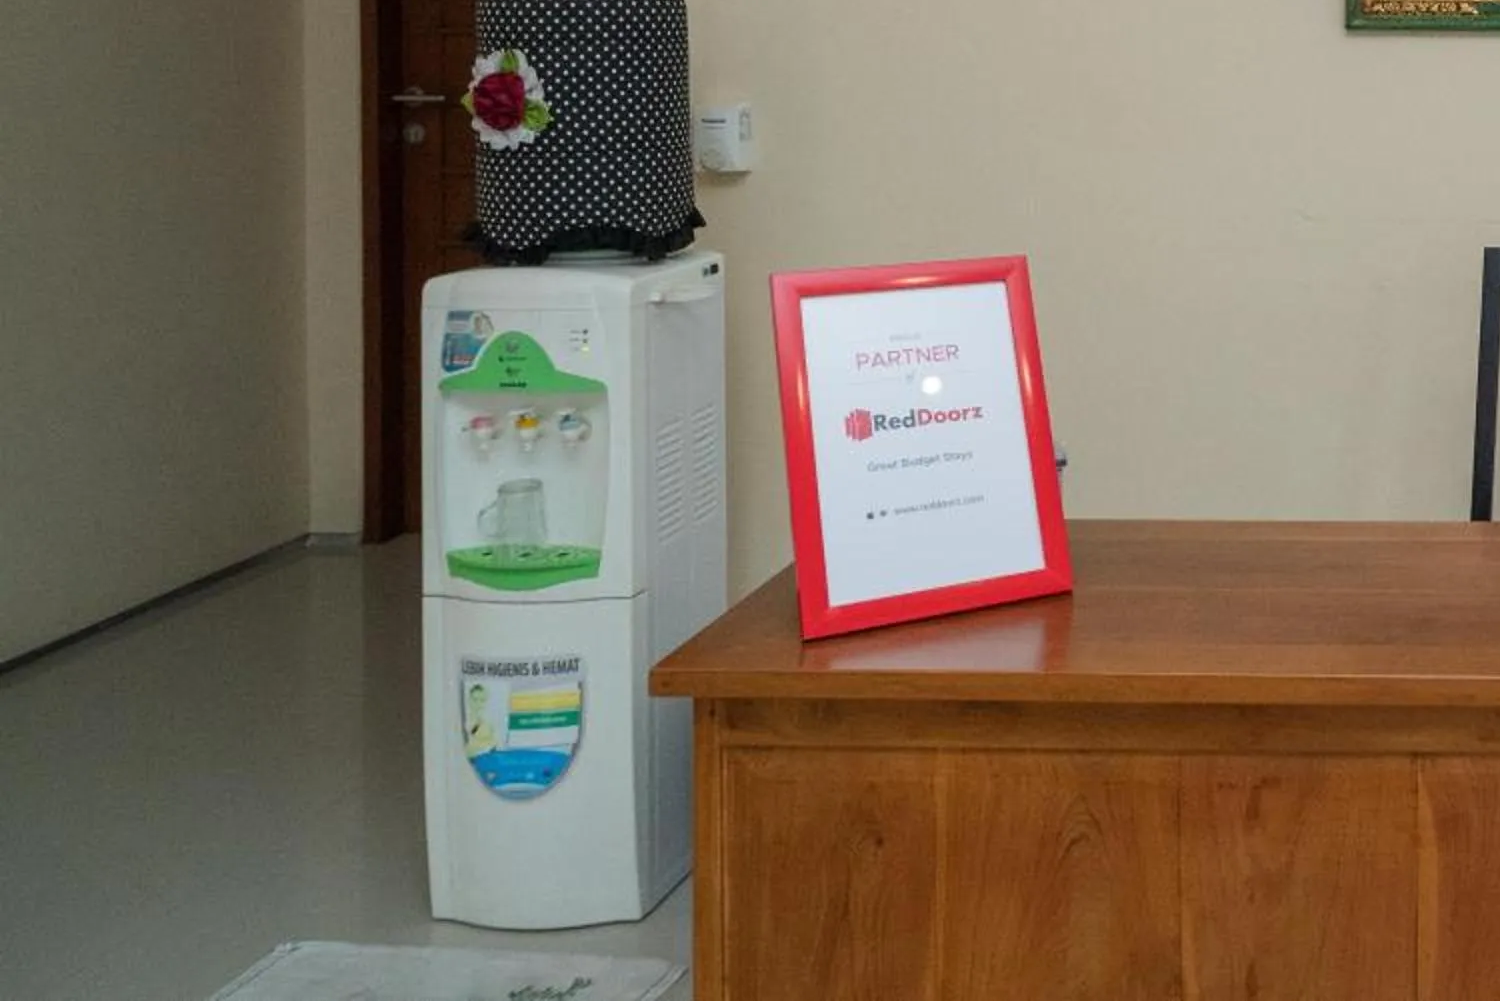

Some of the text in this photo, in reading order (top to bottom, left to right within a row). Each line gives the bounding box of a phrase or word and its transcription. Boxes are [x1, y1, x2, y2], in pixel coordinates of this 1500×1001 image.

[855, 343, 960, 372] PARTNER
[873, 406, 983, 431] RedDoorz
[901, 454, 940, 467] Budget
[542, 657, 581, 675] HEMAT
